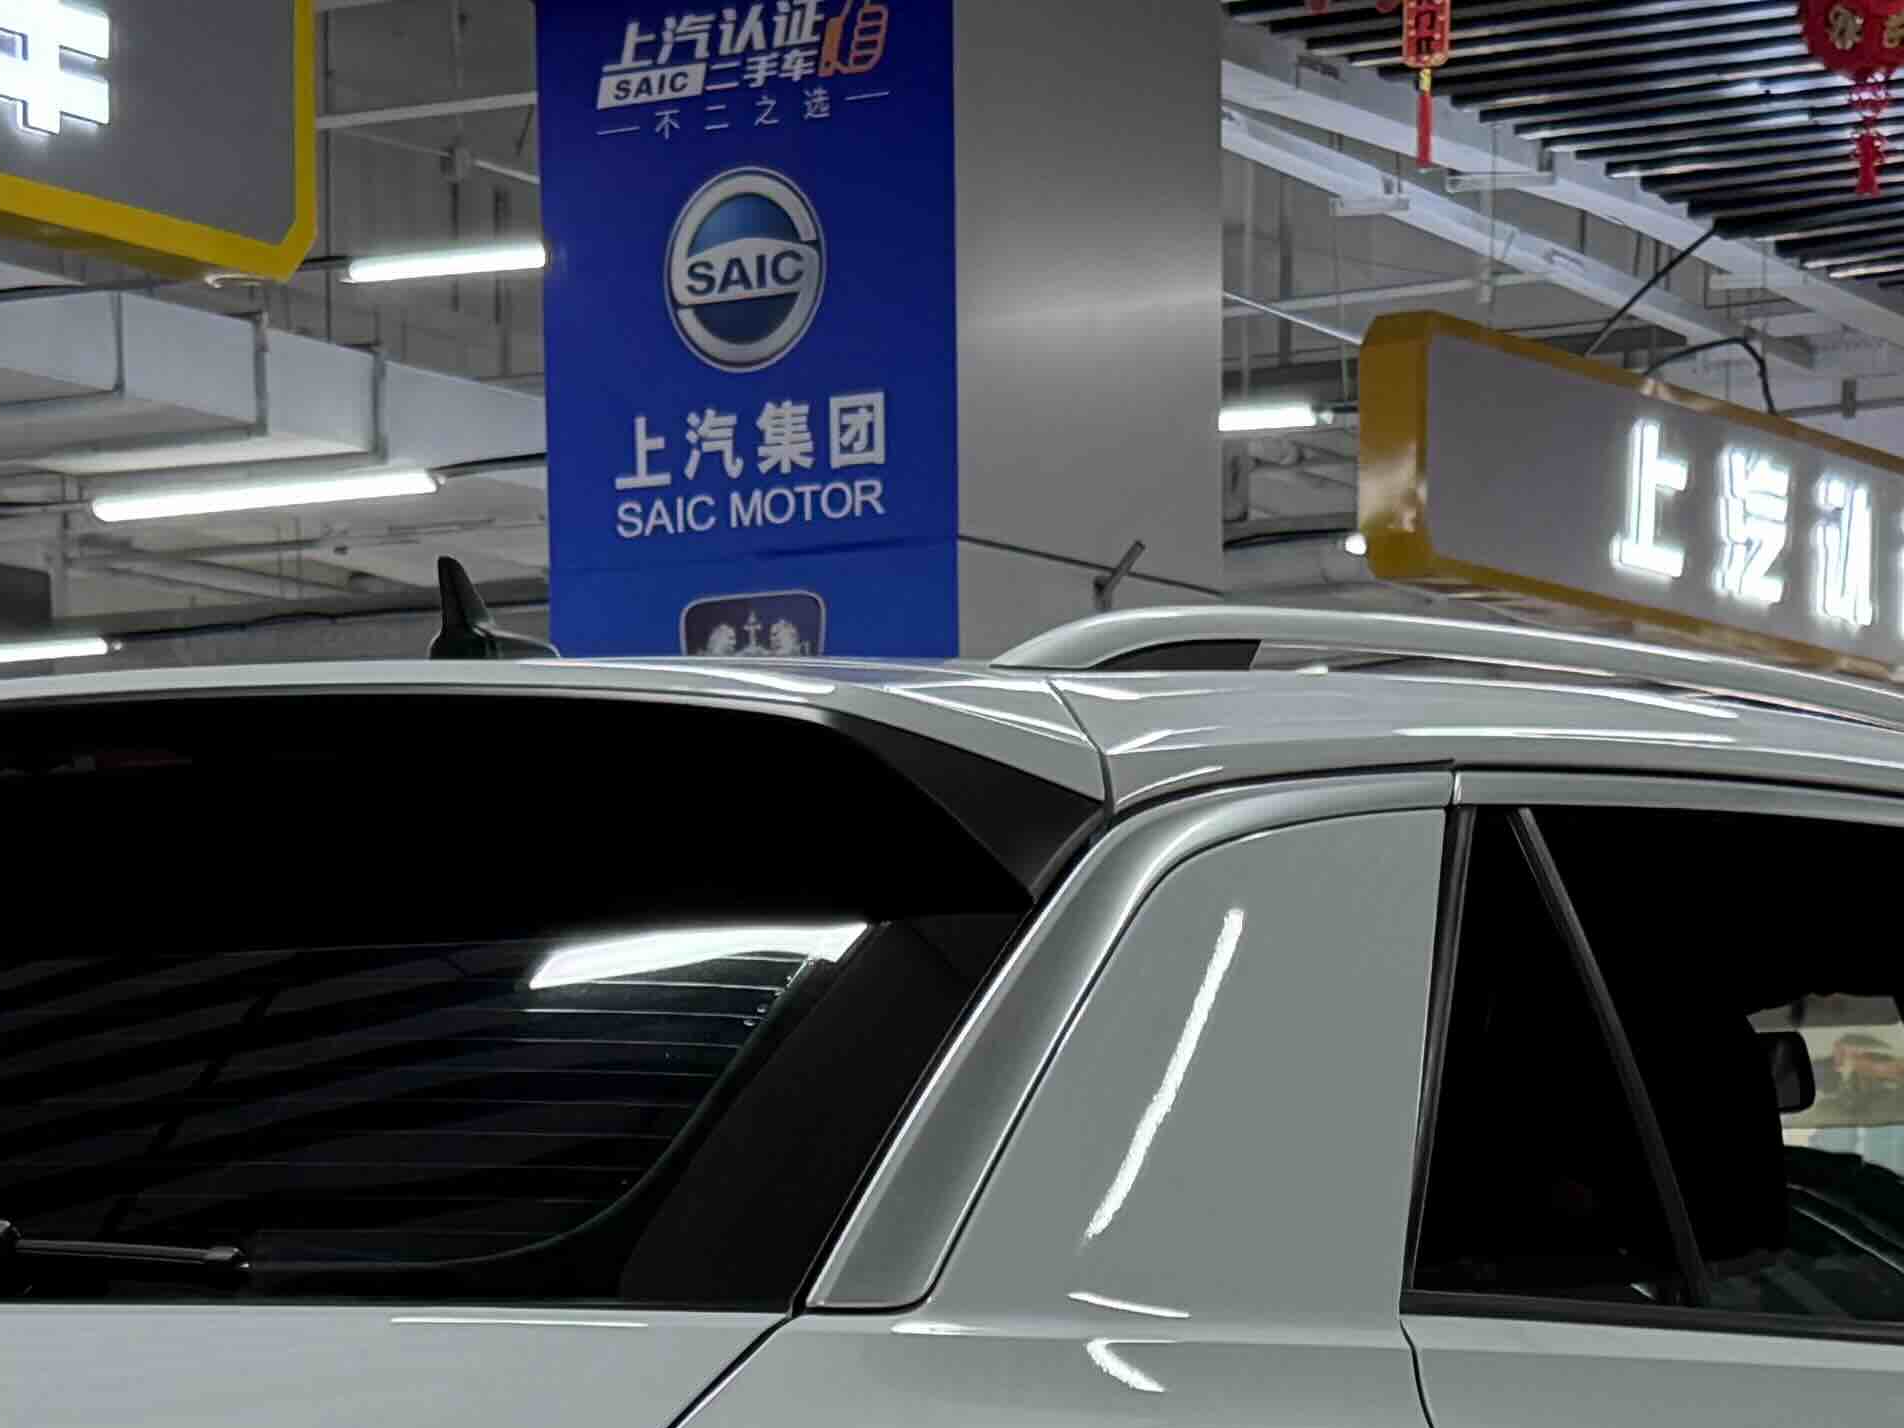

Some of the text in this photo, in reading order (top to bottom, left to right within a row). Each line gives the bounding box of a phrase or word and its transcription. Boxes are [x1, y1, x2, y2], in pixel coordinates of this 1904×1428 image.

[602, 0, 824, 73] 上汽认证
[613, 48, 817, 100] SAIC 二手车
[655, 88, 831, 139] 不二之选
[685, 248, 804, 295] SAIC
[614, 391, 887, 490] 上汽集团
[616, 480, 886, 539] SAIC MOTOR
